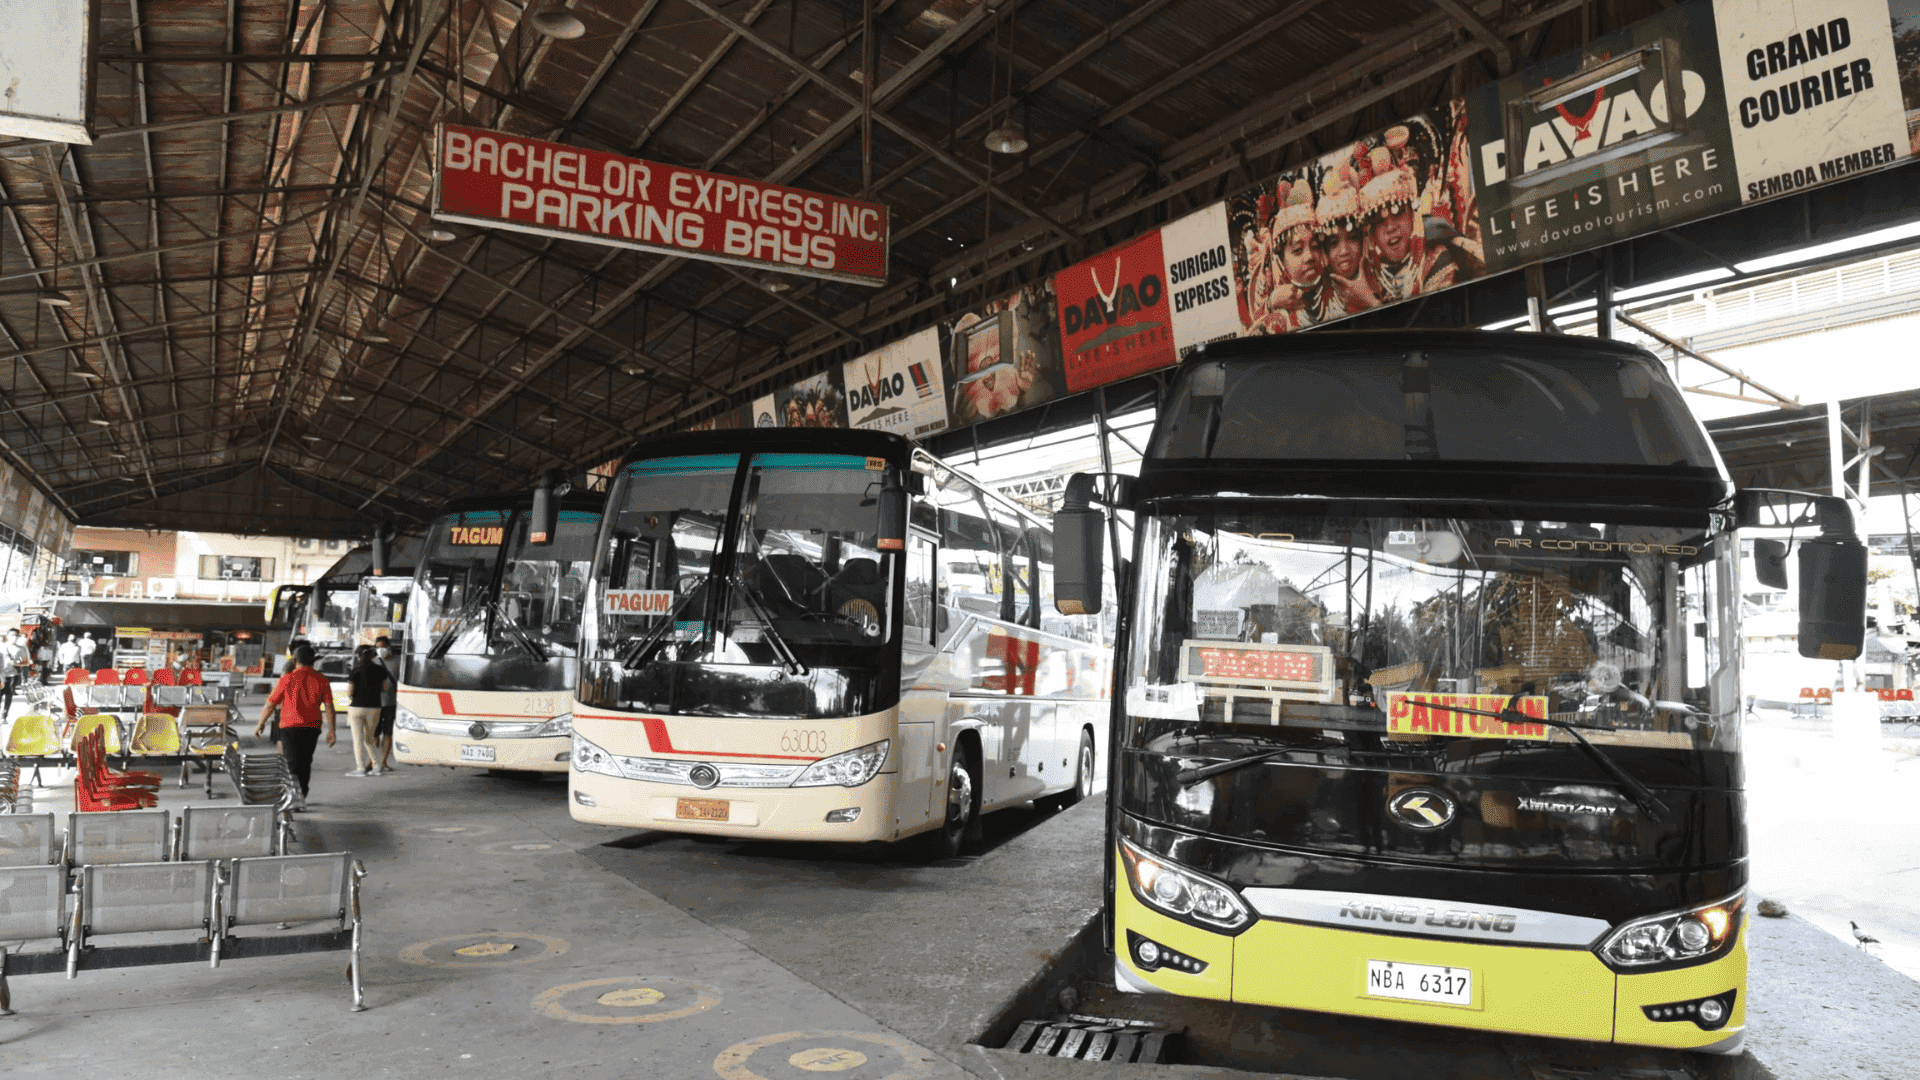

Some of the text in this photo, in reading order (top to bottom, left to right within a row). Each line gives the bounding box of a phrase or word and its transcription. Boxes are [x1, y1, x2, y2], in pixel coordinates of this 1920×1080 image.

[1746, 17, 1851, 81] GRAND
[1739, 58, 1874, 129] COURIER
[1481, 70, 1706, 187] DAVAO
[445, 131, 651, 201] BACHELOR
[1618, 148, 1718, 196] HERE
[1747, 143, 1896, 200] SEMBOA MEMBER
[501, 181, 836, 269] PARKING BAYS
[1495, 183, 1723, 256] www.davaotourism.com
[1170, 245, 1227, 284] SURIGAO
[1064, 274, 1162, 336] DAVAO
[1174, 275, 1230, 313] EXPRESS
[1124, 326, 1168, 352] HERE
[849, 372, 904, 412] DAVAO
[885, 411, 909, 428] HERE
[451, 527, 503, 545] TAGUM
[607, 593, 669, 612] TAGUM
[1390, 694, 1545, 736] PANTUKAN
[781, 730, 827, 753] 63003
[1425, 907, 1517, 933] LONG
[1371, 969, 1467, 996] NBA 6317
